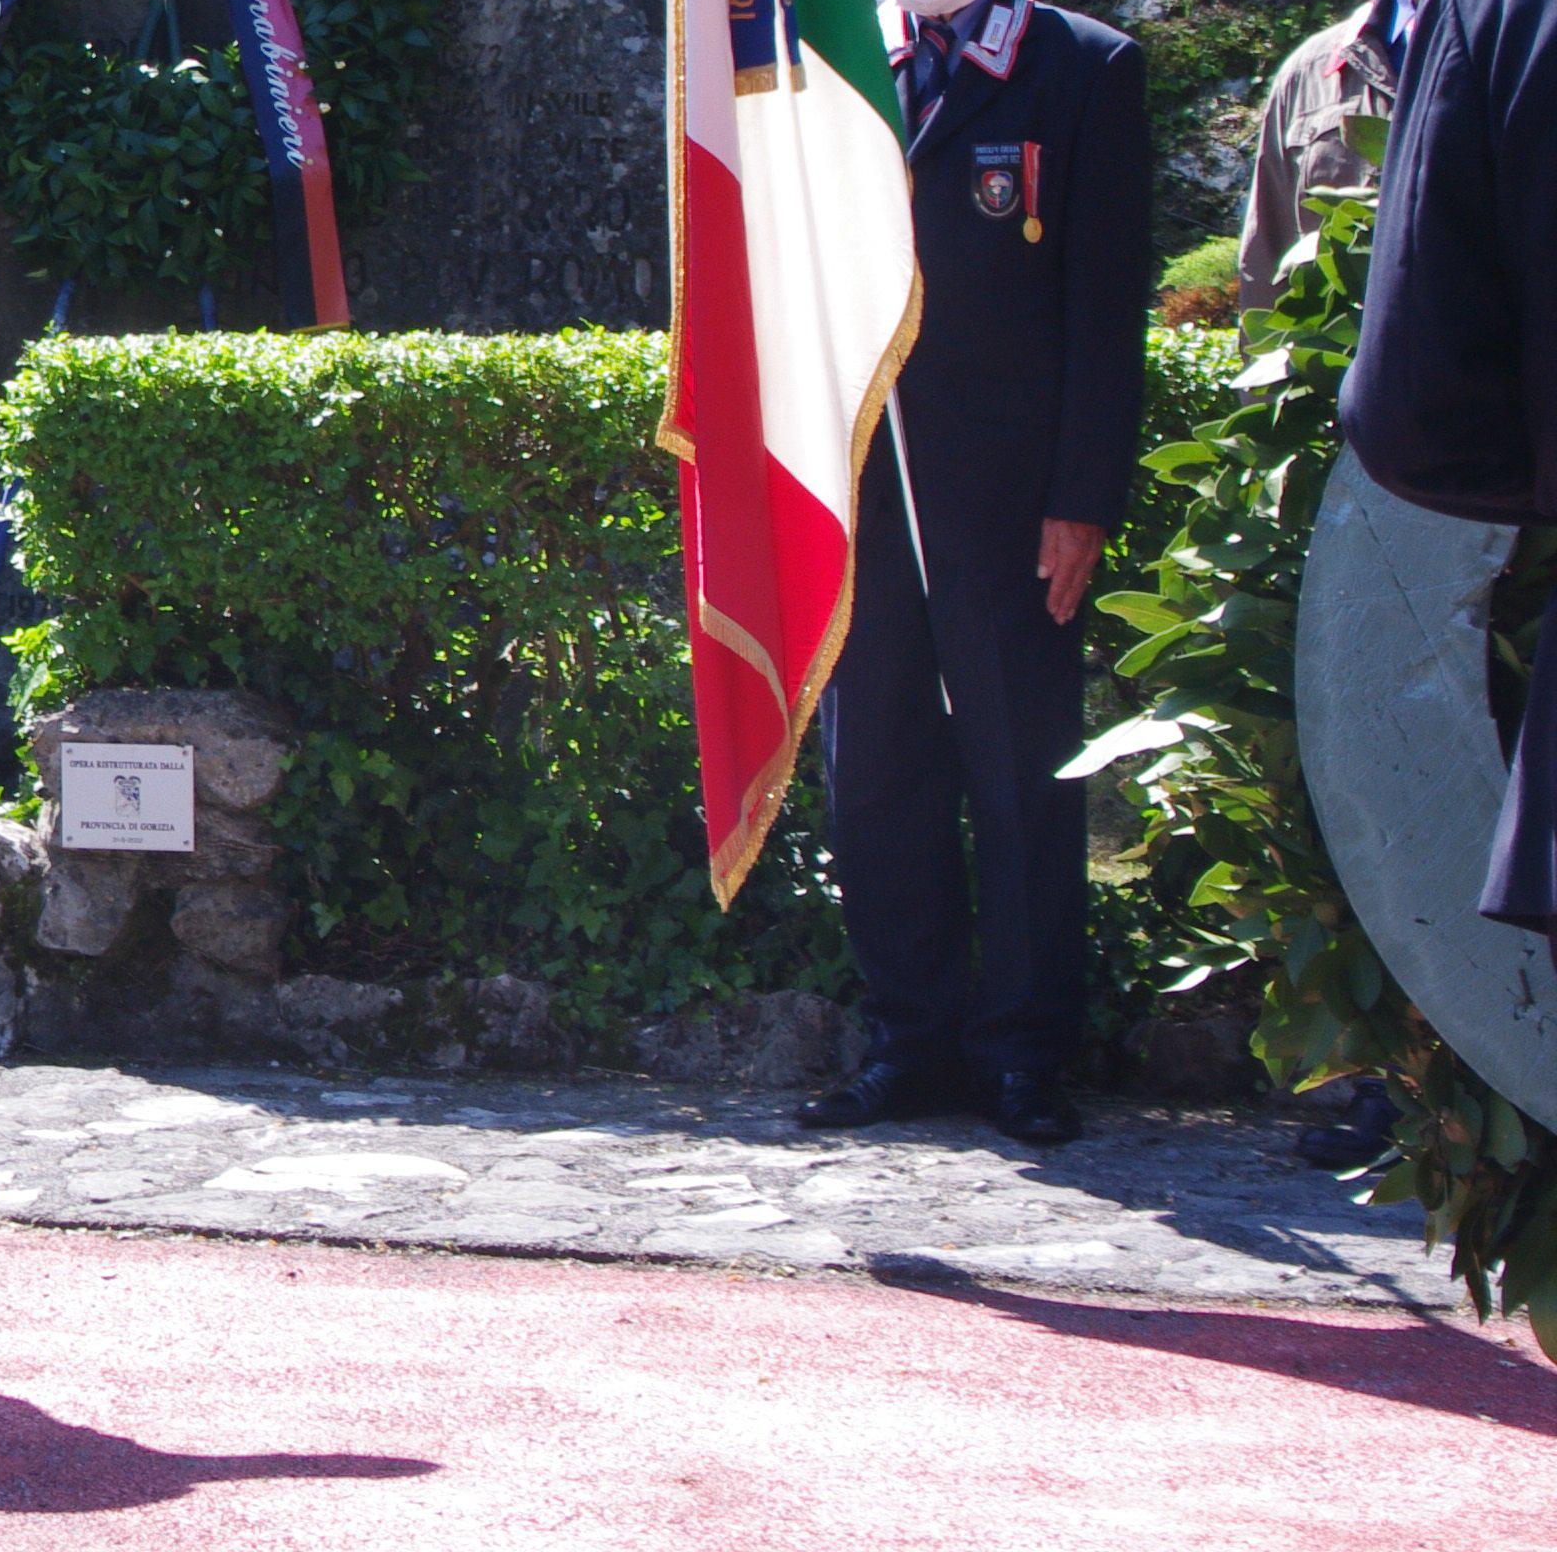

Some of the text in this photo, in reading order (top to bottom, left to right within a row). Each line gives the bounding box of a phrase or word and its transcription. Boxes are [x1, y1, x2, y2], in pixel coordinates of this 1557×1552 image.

[69, 760, 185, 770] OPERA RISTRUTTURATA DALLA
[80, 821, 175, 831] PROVINCIA DI GORIZIA
